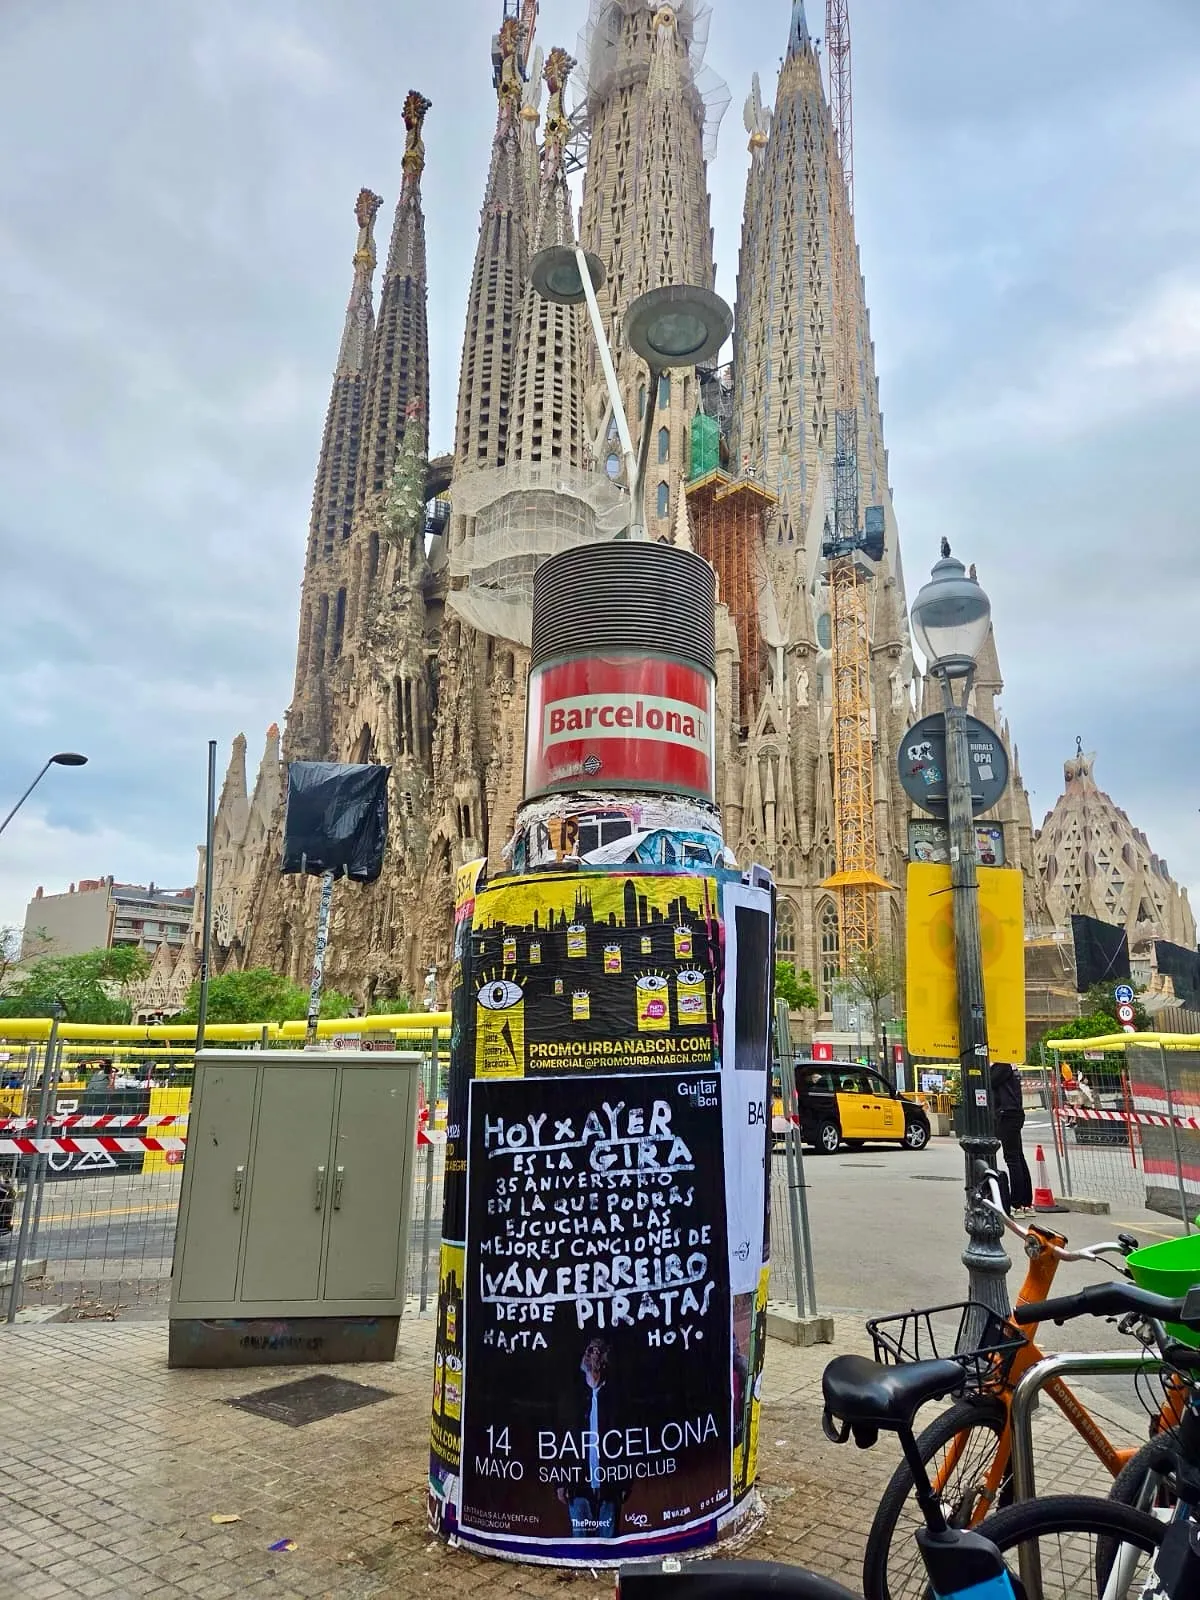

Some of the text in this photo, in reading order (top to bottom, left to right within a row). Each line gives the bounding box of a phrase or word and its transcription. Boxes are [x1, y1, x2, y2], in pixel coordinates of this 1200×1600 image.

[550, 701, 695, 738] Barcelona
[529, 1037, 711, 1057] PROMOURBANABCN.COM
[529, 1053, 711, 1069] COMERCIAL@PROMOURBANABCN.COM
[677, 1080, 717, 1096] Guitar
[698, 1095, 718, 1107] Bcn
[484, 1112, 548, 1148] HOY
[581, 1100, 673, 1145] AYER
[513, 1136, 693, 1175] ES LA GIRA
[496, 1172, 673, 1196] 35 ANIVERSARIO
[487, 1198, 511, 1215] EN
[520, 1194, 546, 1217] LA
[554, 1192, 599, 1213] QUE
[505, 1209, 671, 1238] ESCUCHAR LAS
[480, 1224, 712, 1260] MEJORES CANCIONES DE
[556, 1247, 708, 1295] FERREIRO
[496, 1280, 715, 1329] DESDE PIRATAS
[483, 1329, 548, 1353] HASTA
[486, 1424, 512, 1456] 14
[538, 1413, 719, 1461] BARCELONA
[475, 1455, 677, 1483] MAYO SANT JORDI CLUB
